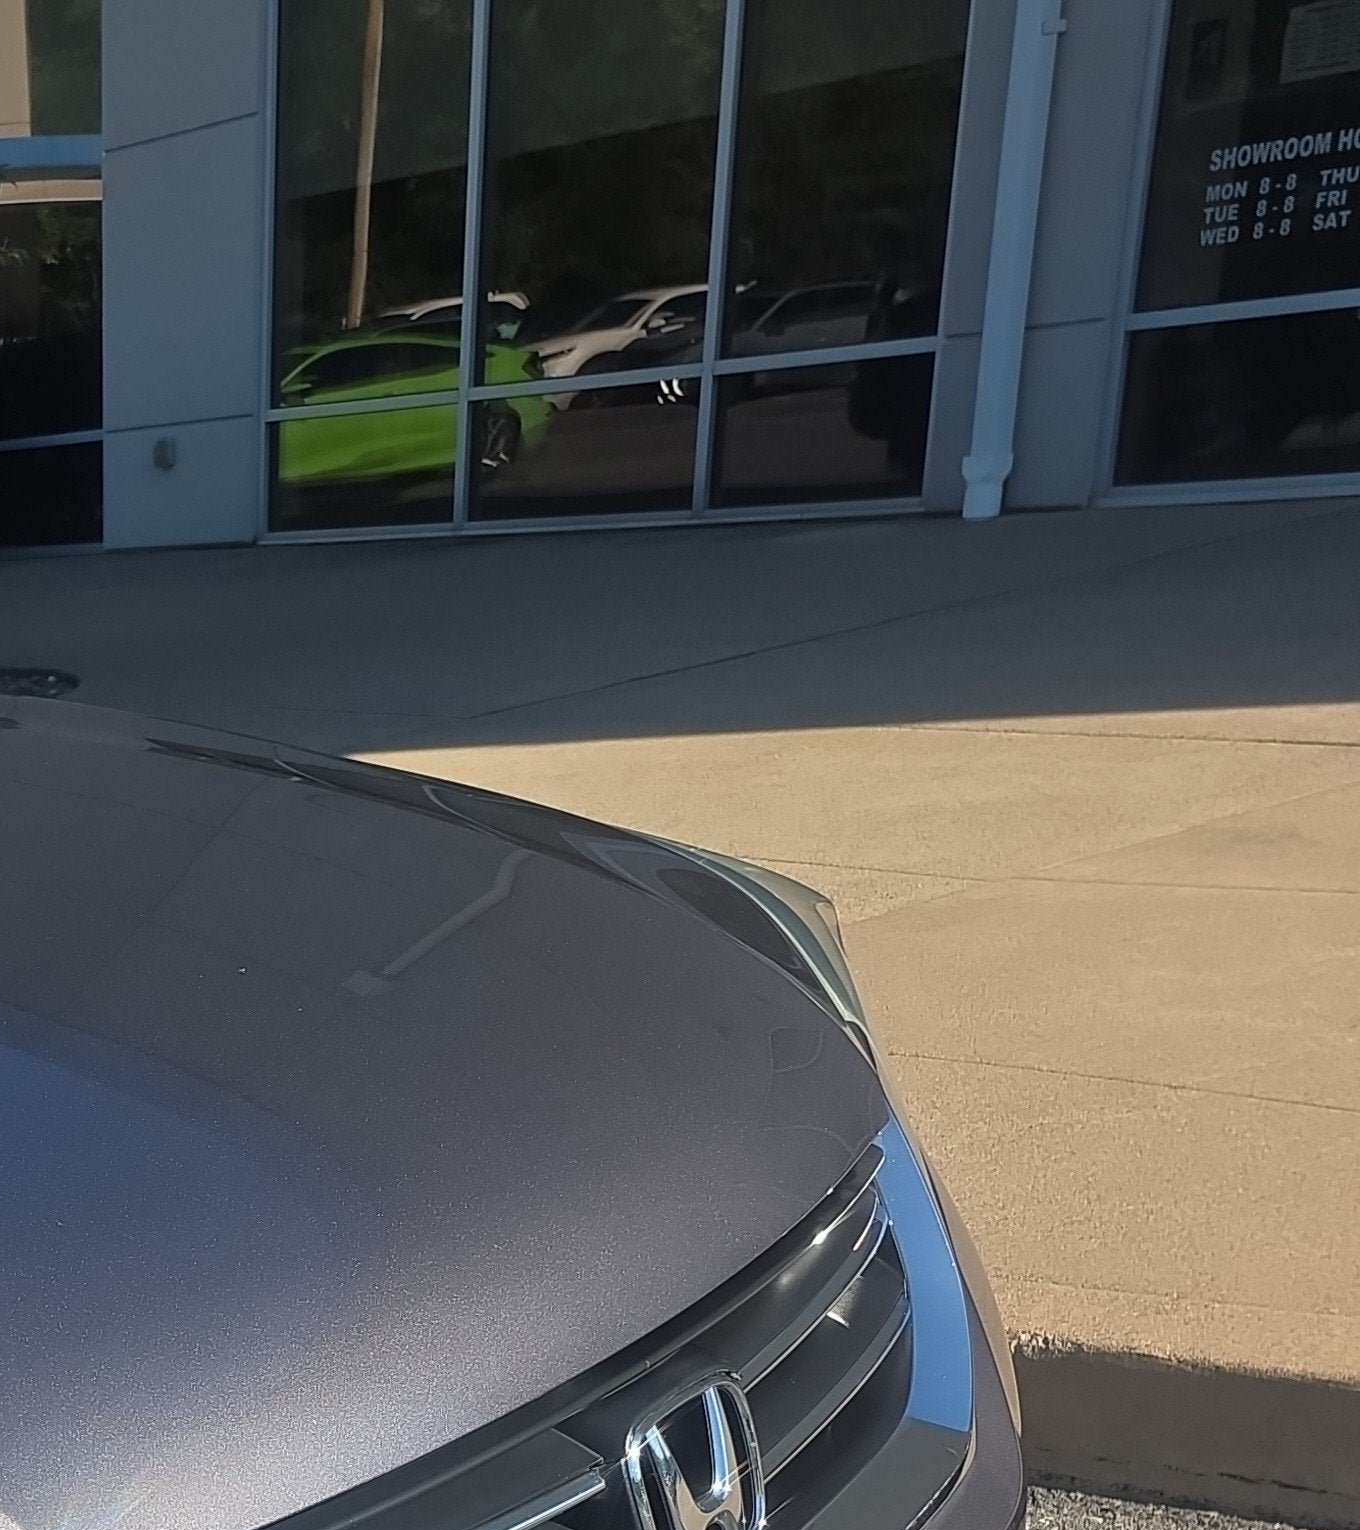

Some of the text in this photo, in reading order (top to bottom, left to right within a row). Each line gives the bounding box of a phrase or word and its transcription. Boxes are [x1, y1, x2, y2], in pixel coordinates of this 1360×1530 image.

[1209, 131, 1332, 172] SHOWROOM
[1203, 203, 1240, 225] TUE
[1315, 189, 1347, 209] FRI
[1205, 180, 1248, 203] MON
[1200, 225, 1240, 247] WED
[1312, 210, 1352, 231] SAT
